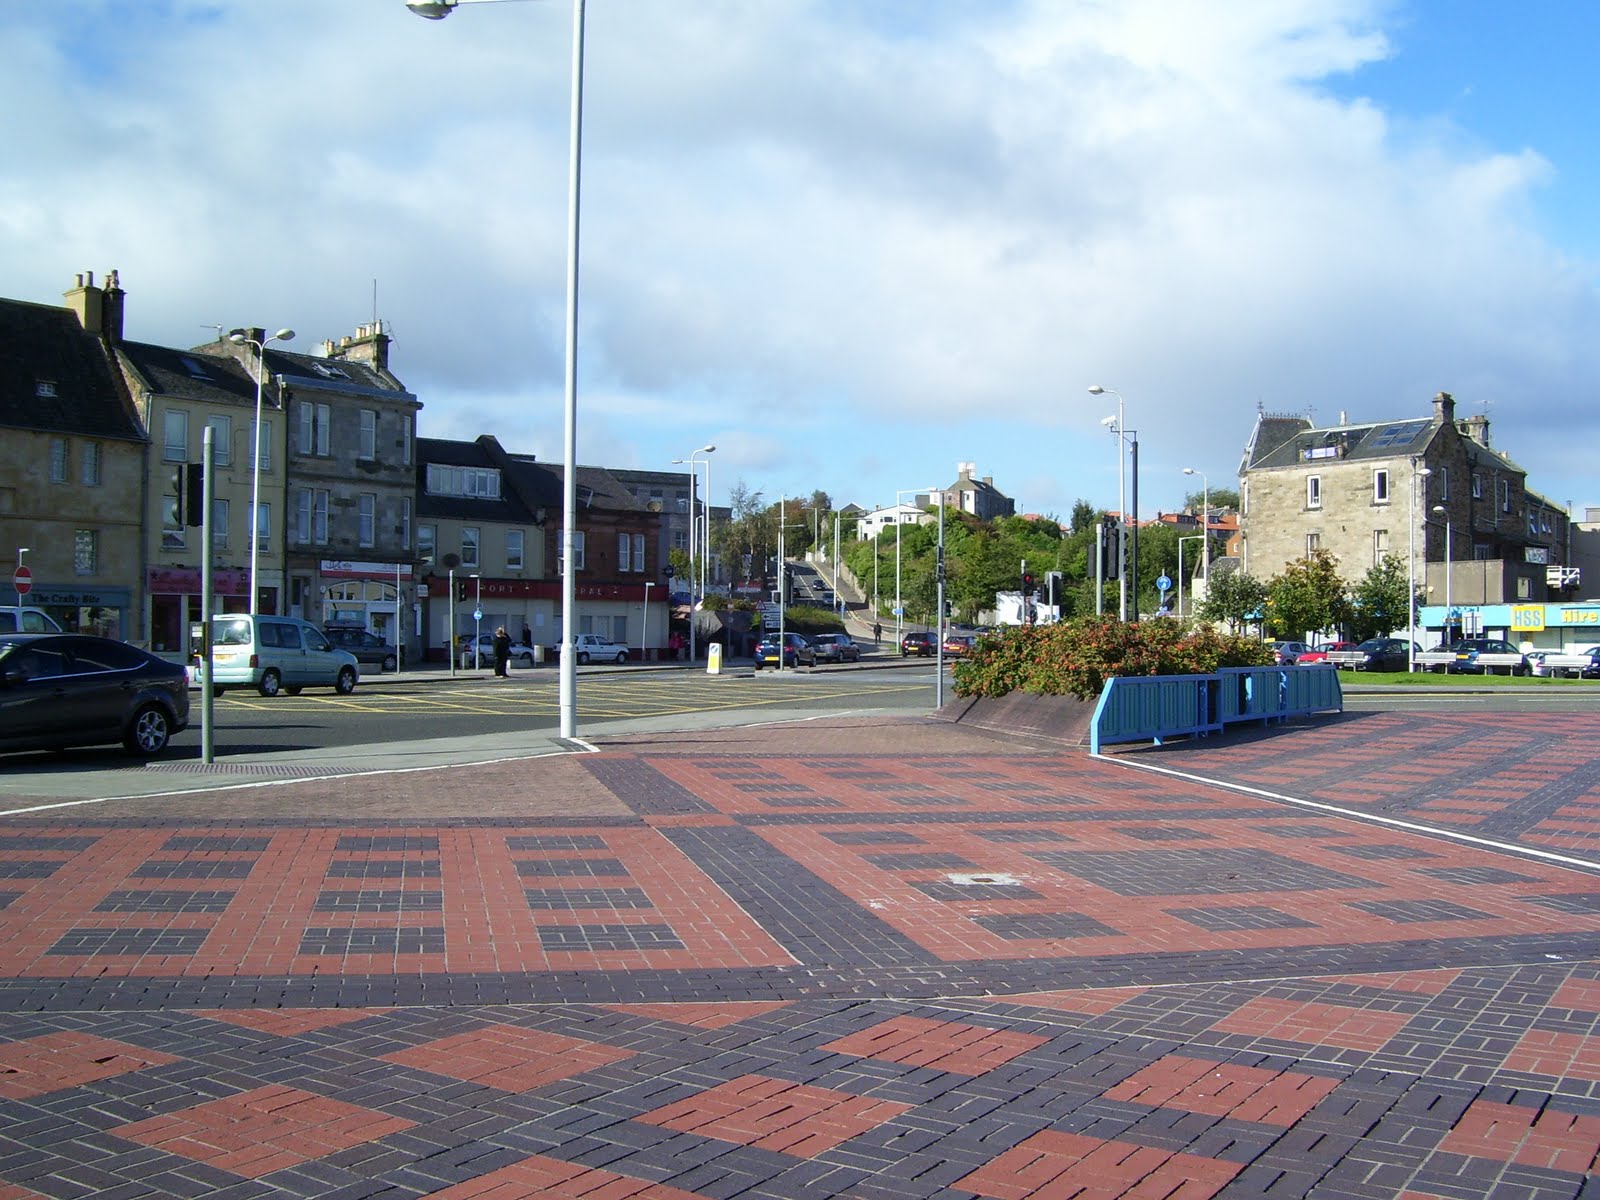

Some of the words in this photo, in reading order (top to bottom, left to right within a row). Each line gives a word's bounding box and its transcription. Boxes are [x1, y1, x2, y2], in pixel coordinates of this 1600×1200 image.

[31, 592, 49, 602] The
[1514, 609, 1541, 627] HSS
[1561, 609, 1599, 623] Hire
